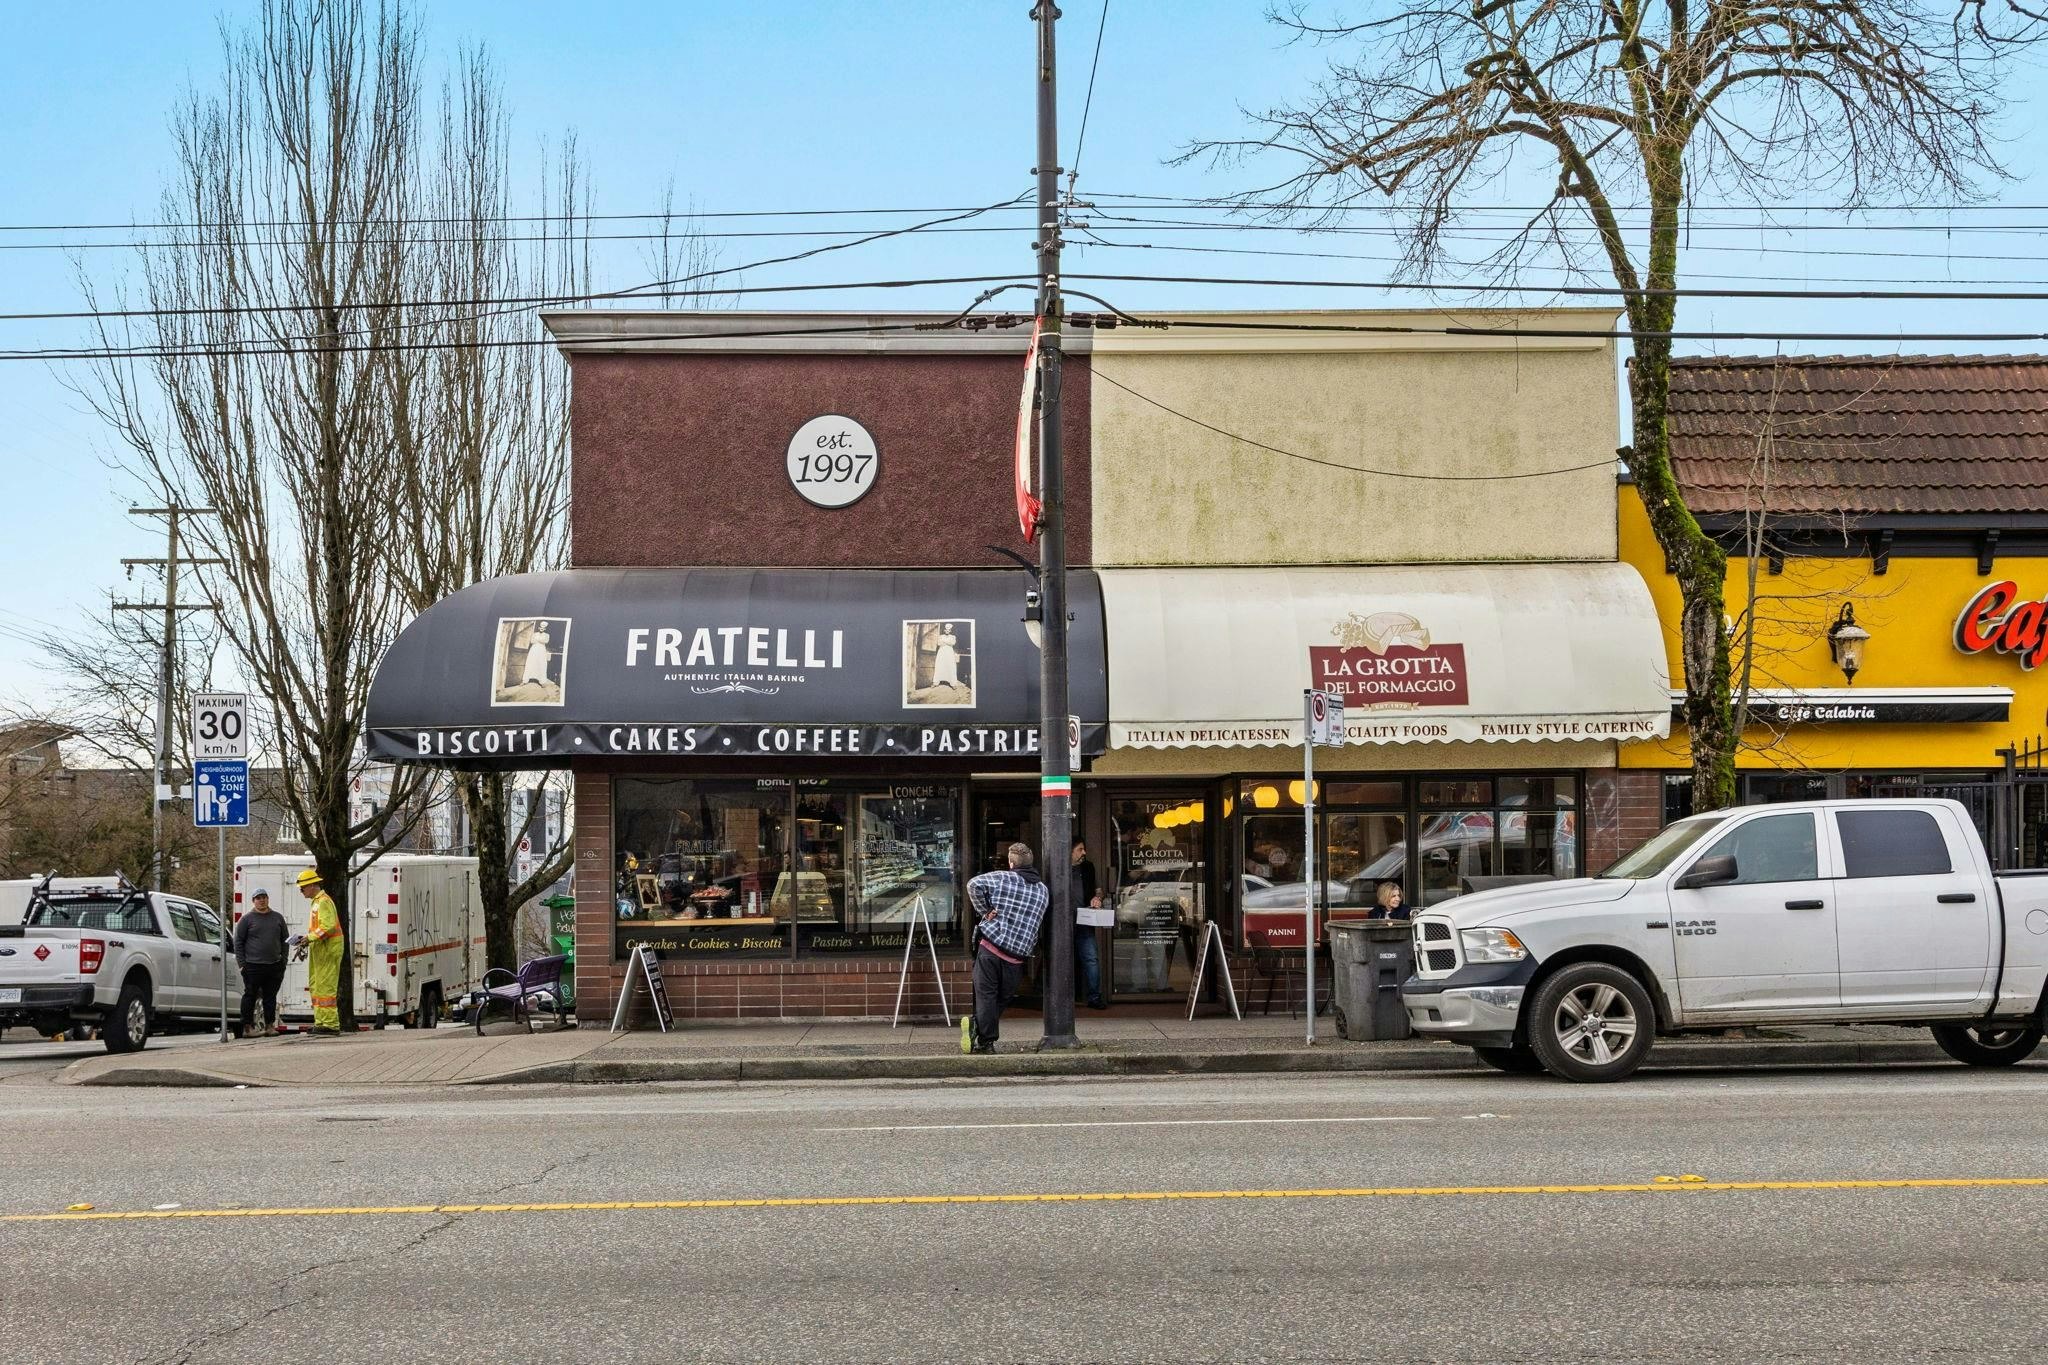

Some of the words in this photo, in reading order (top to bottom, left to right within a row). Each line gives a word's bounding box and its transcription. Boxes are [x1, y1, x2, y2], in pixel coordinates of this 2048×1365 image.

[816, 431, 852, 449] est.
[796, 454, 873, 484] 1997
[1953, 580, 2048, 672] Caf
[626, 627, 843, 668] FRATELLI
[1322, 659, 1353, 677] LA
[1355, 656, 1455, 676] GROTTA
[664, 673, 720, 681] AUTHENTIC
[724, 673, 763, 681] ITALIAN
[767, 674, 805, 683] BAKING
[1324, 681, 1355, 694] DEL
[1358, 679, 1456, 694] FORMAGGIO
[198, 698, 242, 708] MAXIMUM
[1814, 706, 1876, 719] Calabria
[199, 710, 242, 740] 30
[1344, 726, 1399, 738] CIALTY
[1403, 725, 1448, 736] FOODS
[1481, 723, 1531, 736] FAMILY
[1536, 722, 1580, 735] STYLE
[1584, 721, 1654, 734] CATERING
[417, 729, 549, 755] BISCOTTI
[609, 728, 697, 751] CAKES
[757, 728, 860, 752] COFFEE
[921, 729, 1039, 752] PASTRIE
[1127, 731, 1185, 742] ITALIAN
[1190, 729, 1290, 741] DELICATESSEN
[204, 744, 237, 754] km/h
[220, 775, 246, 783] SLOW
[221, 783, 245, 792] ZONE
[1145, 849, 1184, 858] GROTTA
[1676, 920, 1717, 928] RAM
[1268, 928, 1296, 936] PANINI
[1676, 928, 1717, 936] 1500
[626, 937, 677, 949] Ccakes
[689, 937, 730, 949] Cookies
[741, 936, 782, 949] Biscotti
[812, 935, 853, 948] Pastries
[920, 934, 950, 945] Ckes
